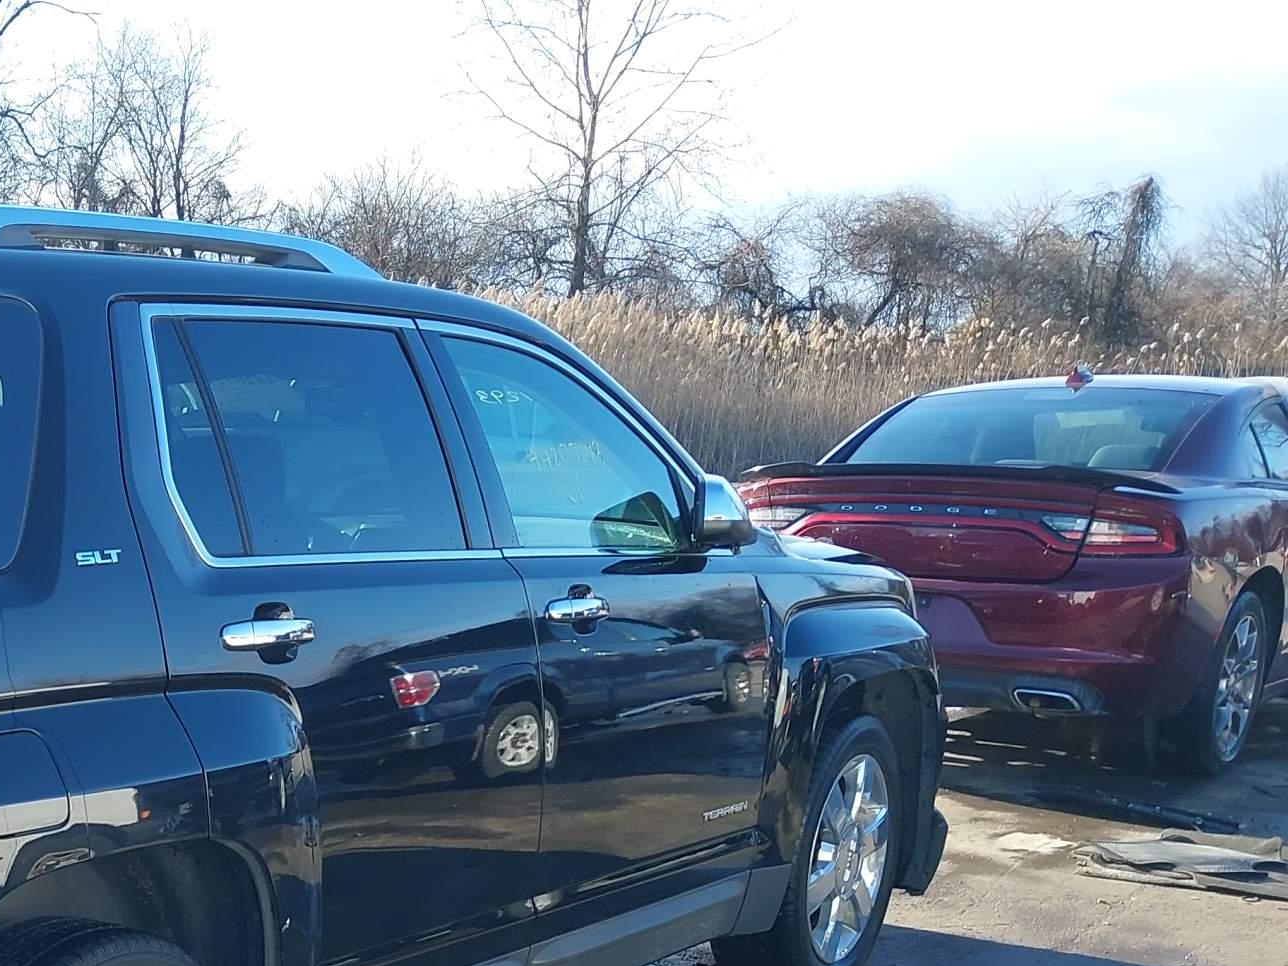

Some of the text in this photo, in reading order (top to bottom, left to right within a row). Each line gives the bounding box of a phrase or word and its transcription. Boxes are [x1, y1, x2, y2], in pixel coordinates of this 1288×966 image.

[840, 504, 997, 515] DODGE
[75, 549, 122, 566] SLT
[703, 800, 748, 821] TERRAIN
